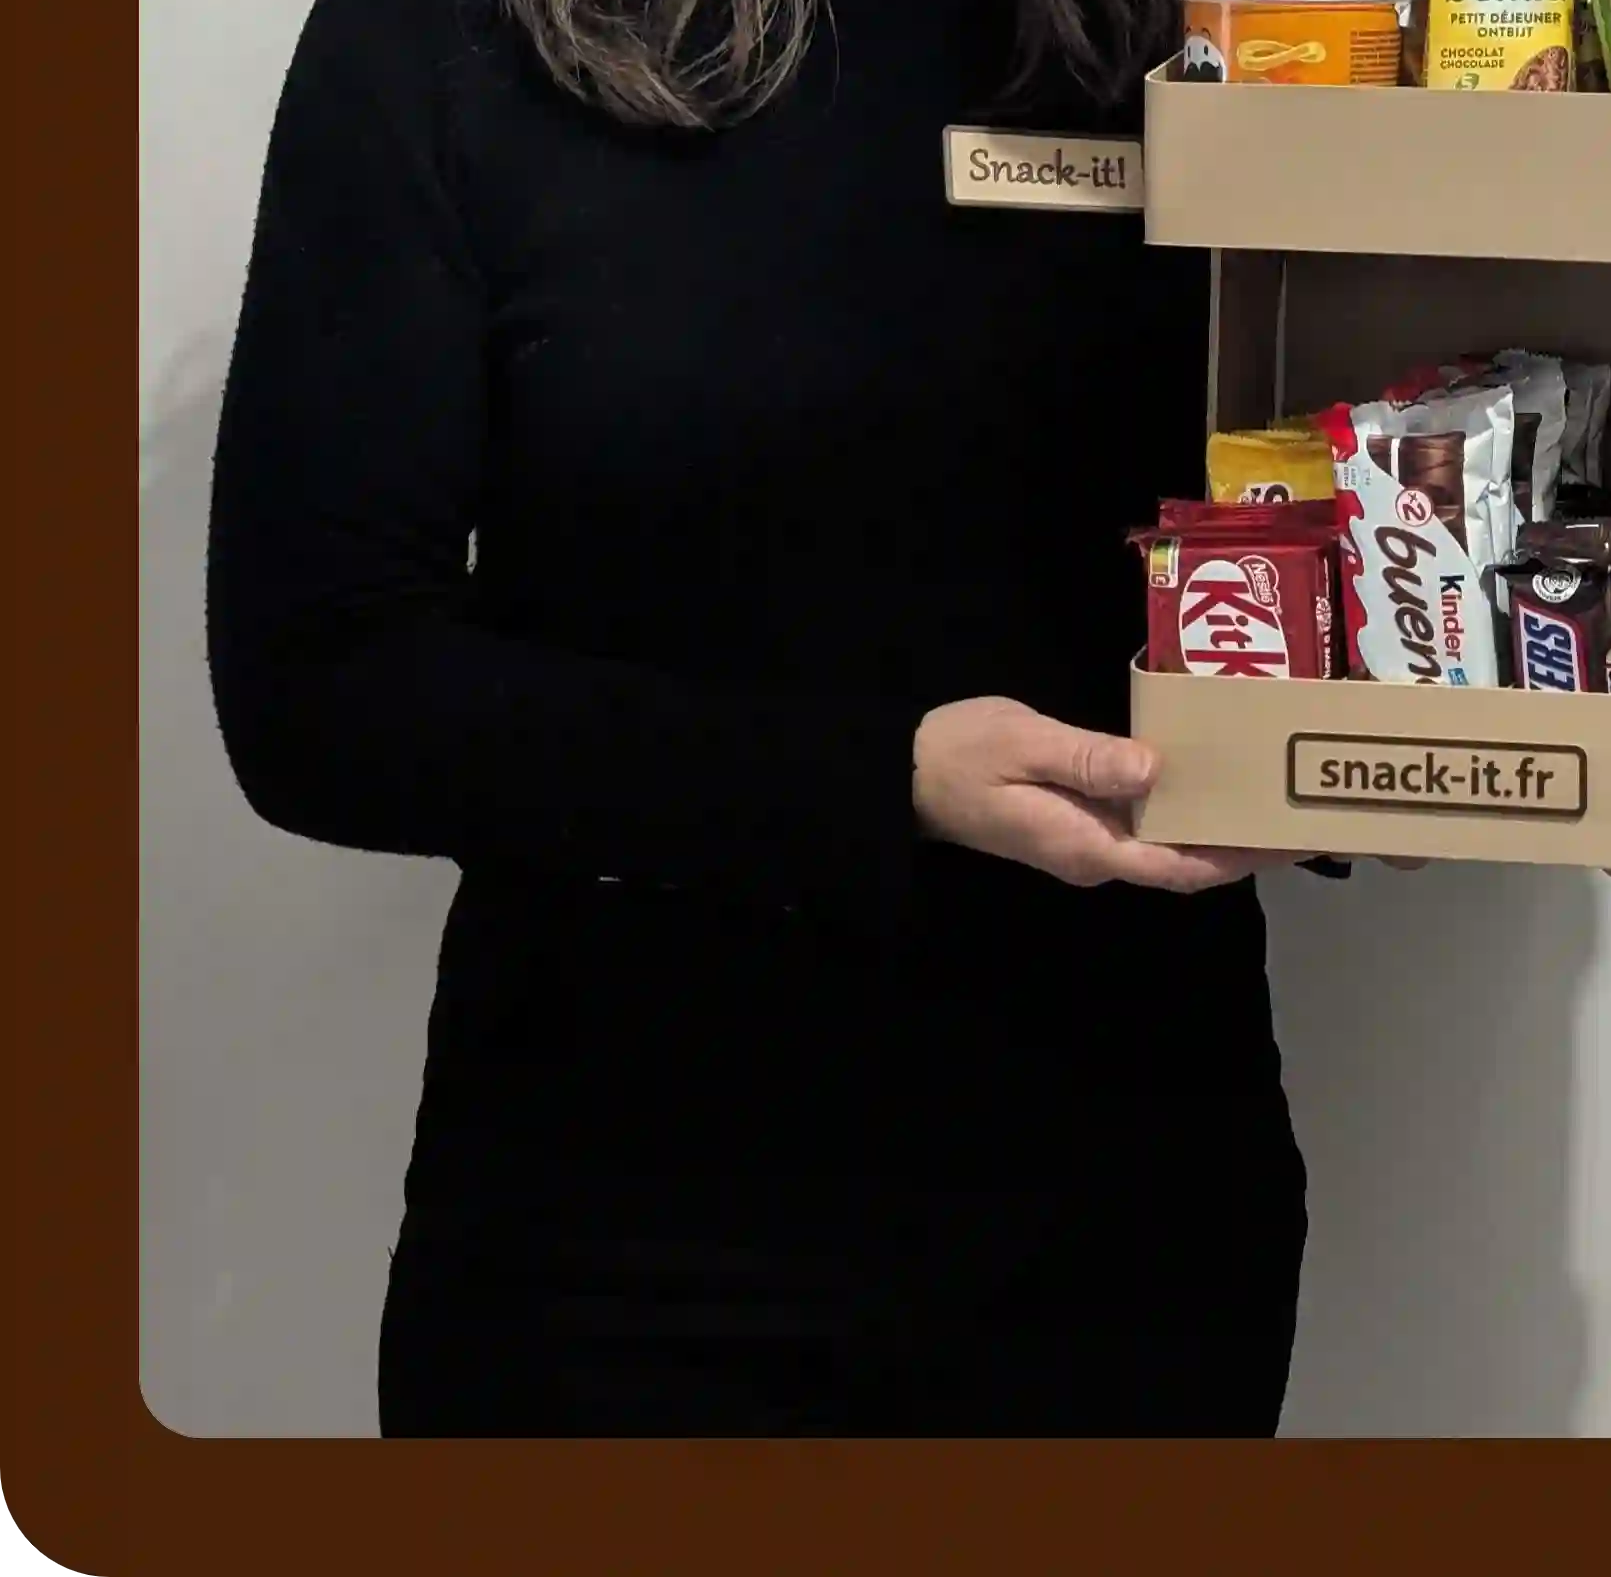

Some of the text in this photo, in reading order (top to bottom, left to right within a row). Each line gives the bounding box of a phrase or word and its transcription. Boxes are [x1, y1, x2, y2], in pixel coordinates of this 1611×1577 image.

[1450, 10, 1563, 25] PETIT DÉJEUNER
[1477, 26, 1534, 38] ONTBIJT
[1440, 47, 1505, 58] CHOCOLAT
[1439, 59, 1505, 70] CHOCOLADE
[969, 147, 1126, 189] Snack-it!
[1439, 574, 1466, 662] Kinder
[1319, 751, 1555, 800] snack-it.fr
